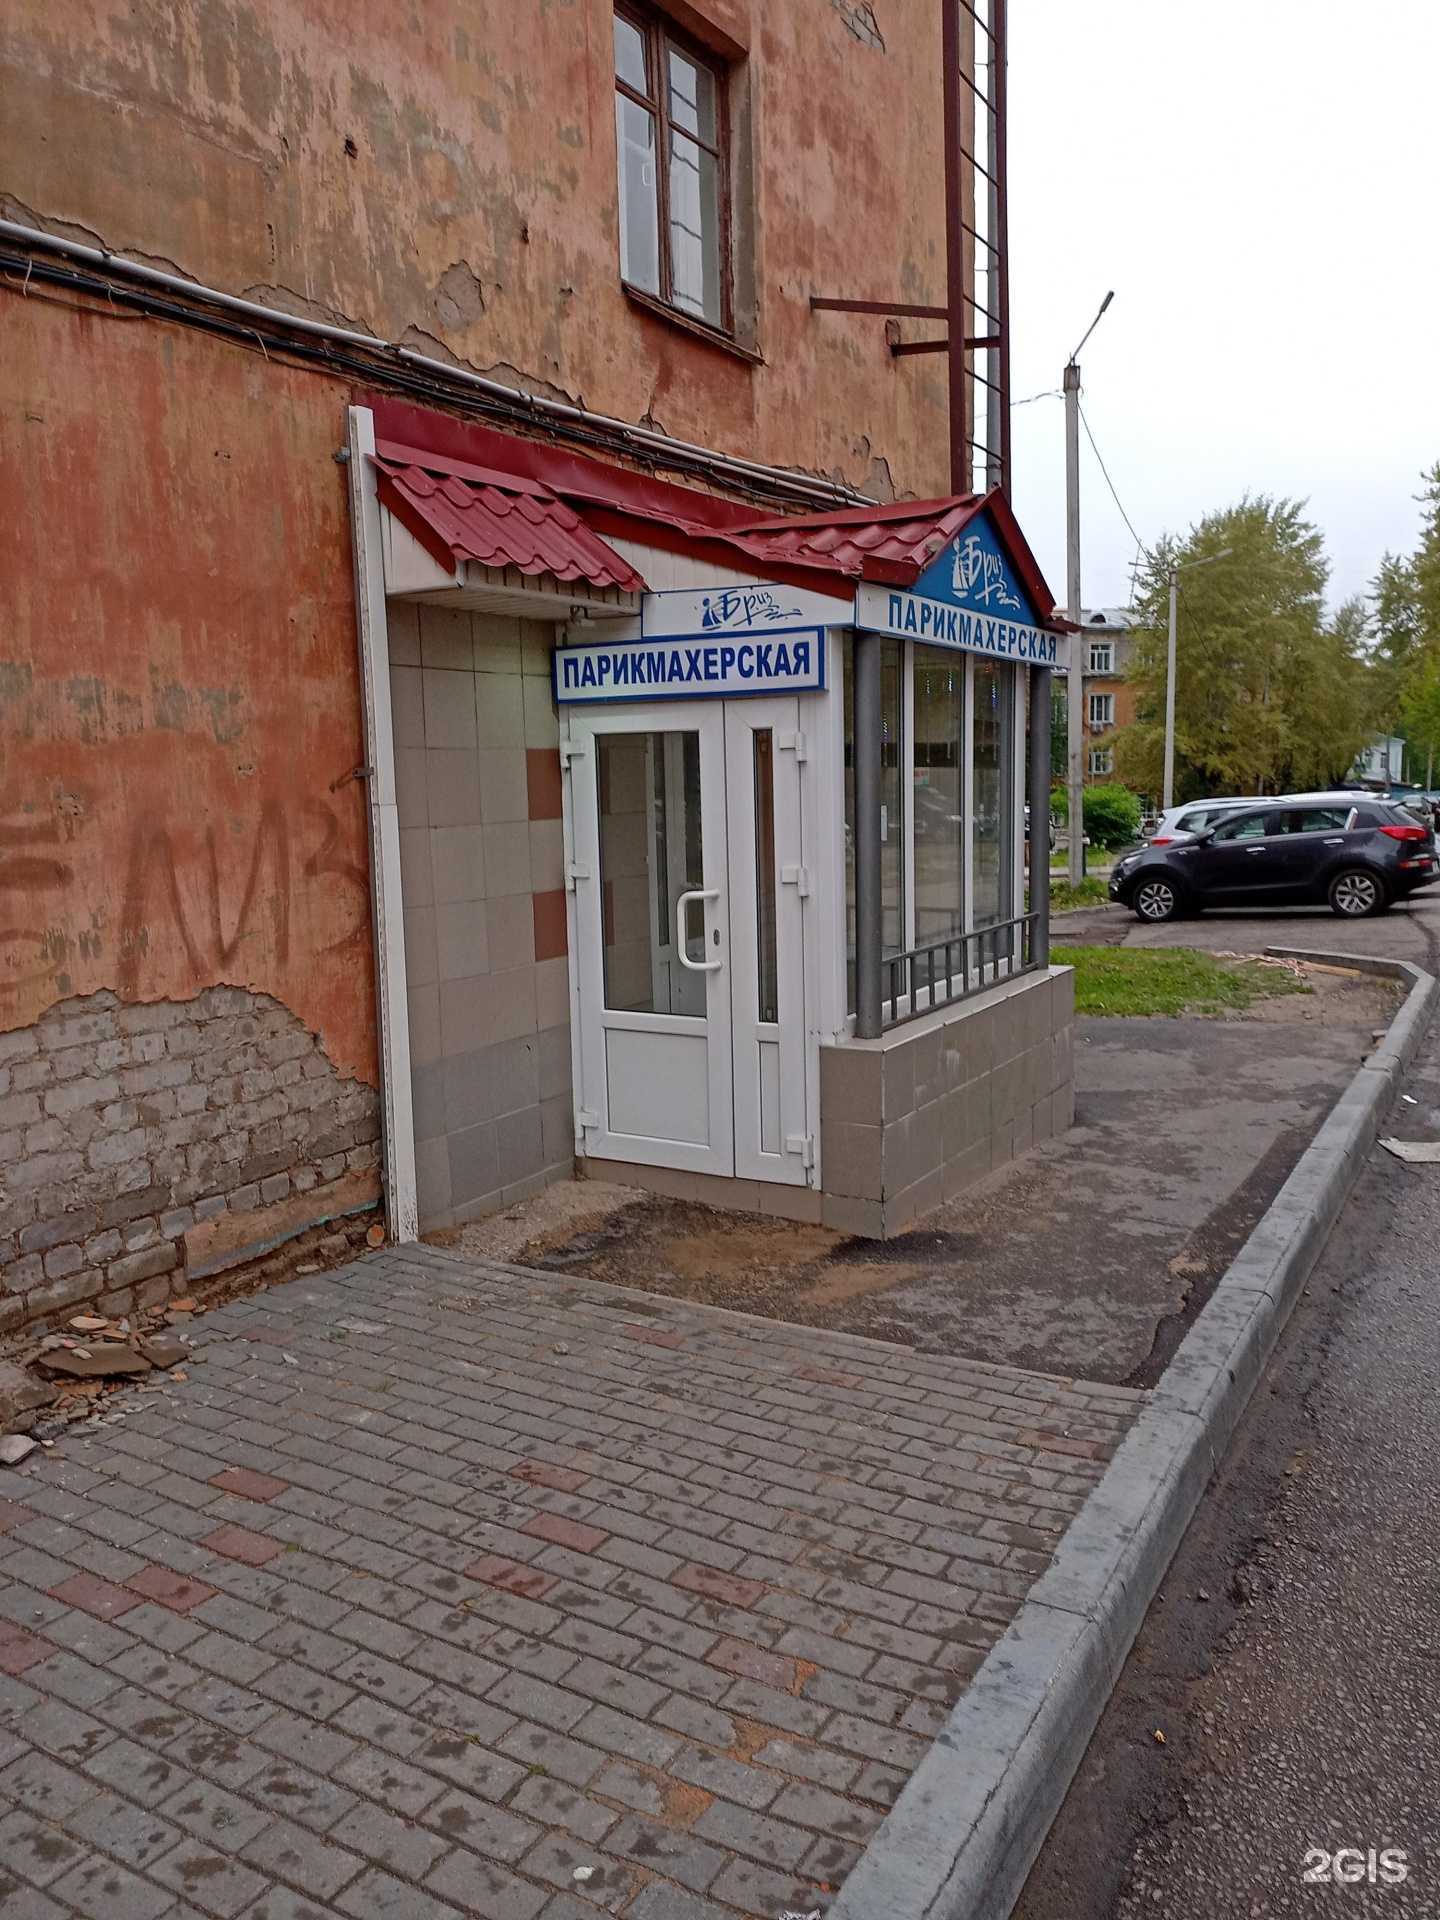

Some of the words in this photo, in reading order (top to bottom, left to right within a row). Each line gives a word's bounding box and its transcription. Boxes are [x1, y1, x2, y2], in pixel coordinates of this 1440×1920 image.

[962, 535, 1008, 606] Бриз
[717, 590, 780, 626] Бриз
[888, 593, 1057, 662] ПАРИКМАХЕРСКАЯ
[563, 641, 811, 689] ПАРИКМАХЕРСКАЯ
